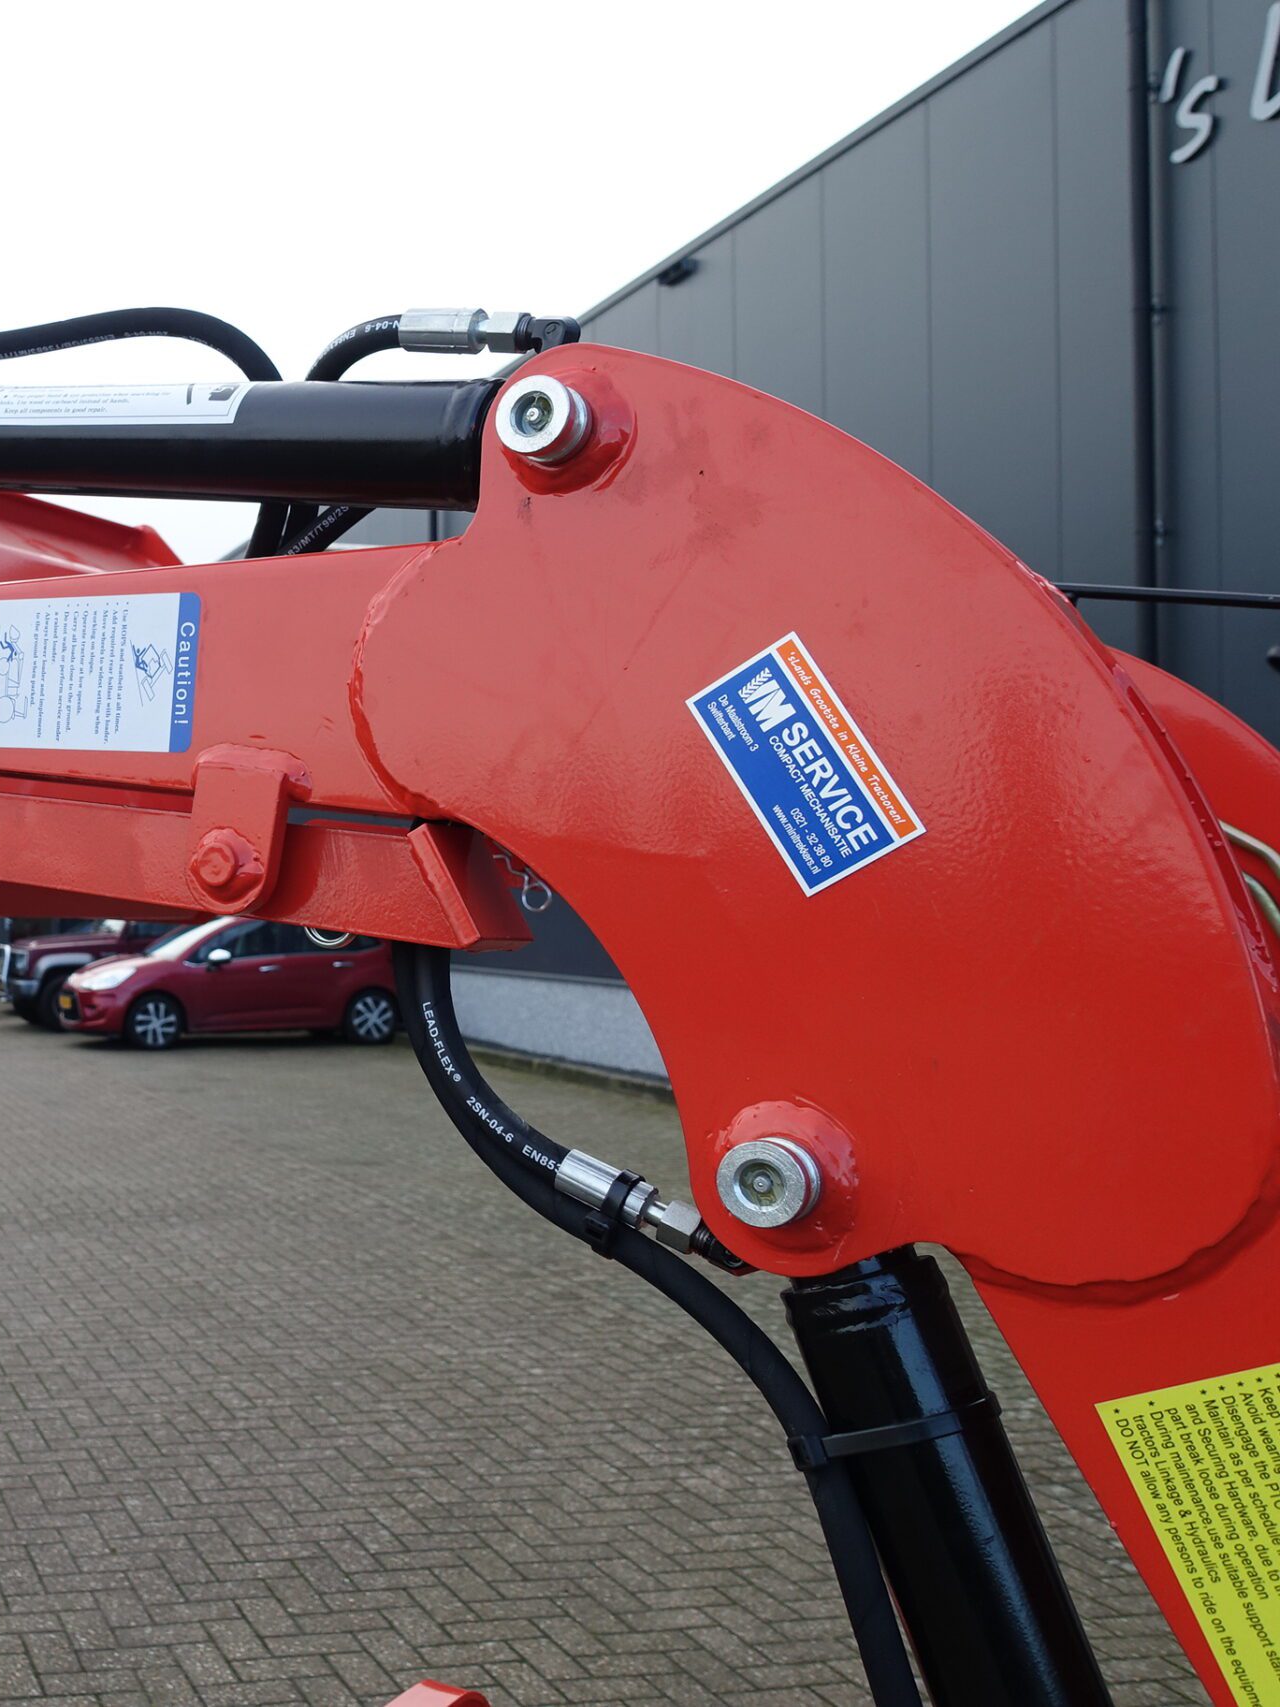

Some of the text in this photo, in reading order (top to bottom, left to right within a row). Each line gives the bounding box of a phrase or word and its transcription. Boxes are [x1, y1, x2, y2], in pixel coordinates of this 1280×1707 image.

[174, 621, 196, 725] Caution!
[708, 702, 735, 740] Swifterbant
[718, 695, 728, 706] De
[725, 705, 753, 745] Maalstroom
[769, 736, 852, 857] COMPACT MECHANISATIE
[782, 722, 878, 851] SERVICE
[810, 689, 839, 728] Grootste
[838, 731, 848, 740] in
[846, 744, 867, 772] Kleine
[868, 775, 905, 823] Tractoren!
[773, 805, 821, 874] www.minitrekkers.nl
[791, 808, 807, 828] 0321
[807, 833, 818, 845] 32
[814, 844, 825, 856] 38
[820, 855, 833, 867] 80
[466, 1095, 515, 1143] 2SN-04-6
[1220, 1395, 1259, 1457] Disengage
[1253, 1460, 1270, 1479] the
[1239, 1392, 1266, 1424] Avoid
[1258, 1387, 1280, 1418] Keep
[1132, 1414, 1221, 1583] tractors Linkage & Hydraulics
[1164, 1407, 1268, 1599] part break loose during operation
[1184, 1403, 1280, 1581] and Securing Hardware, due to
[1203, 1399, 1280, 1545] Maintain as per schedule
[1115, 1418, 1134, 1437] DO
[1126, 1440, 1149, 1466] NOT
[1139, 1470, 1161, 1499] allow
[1155, 1502, 1173, 1523] any
[1164, 1527, 1197, 1574] persons
[1191, 1576, 1204, 1588] to
[1199, 1591, 1216, 1614] ride
[1211, 1617, 1225, 1633] on
[1220, 1636, 1236, 1655] the
[1149, 1410, 1175, 1449] During
[1218, 1552, 1248, 1598] suitable
[1242, 1601, 1273, 1647] support
